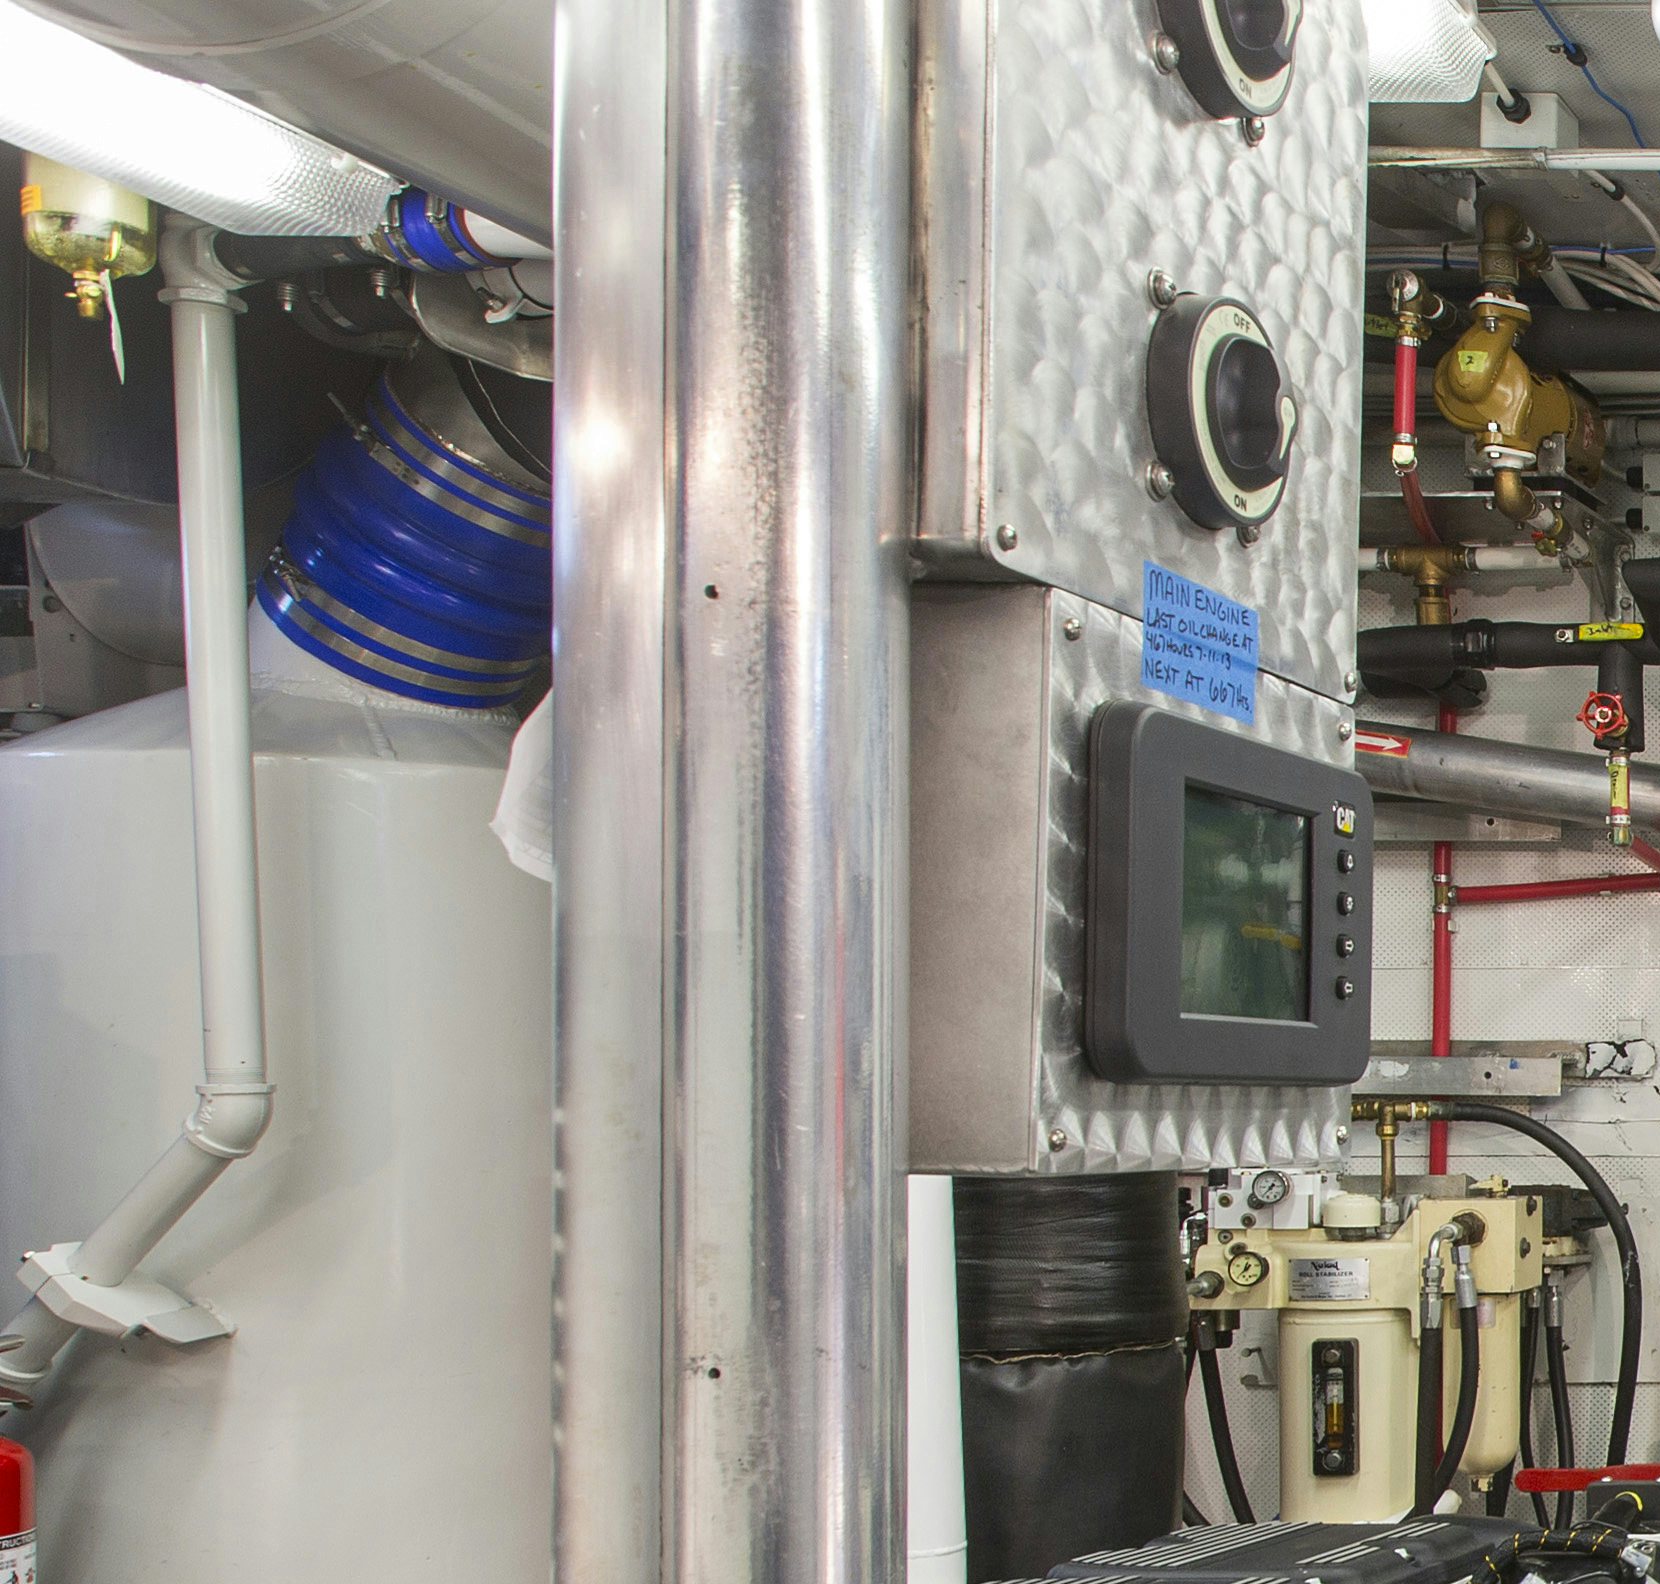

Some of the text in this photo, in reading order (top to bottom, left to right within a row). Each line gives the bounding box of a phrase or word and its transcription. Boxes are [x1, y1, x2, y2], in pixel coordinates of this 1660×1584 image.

[1239, 77, 1252, 99] ON
[1233, 313, 1251, 334] OFF
[1234, 494, 1248, 511] ON
[1150, 569, 1251, 626] MAIN ENGINE
[1145, 631, 1166, 653] 467
[1146, 607, 1254, 655] LAST OIL CHANGE AT
[1144, 658, 1180, 684] NEXT
[1185, 670, 1204, 692] AT
[1209, 676, 1235, 708] 667
[1336, 806, 1356, 834] CAT
[1315, 1270, 1354, 1278] STABILIZER
